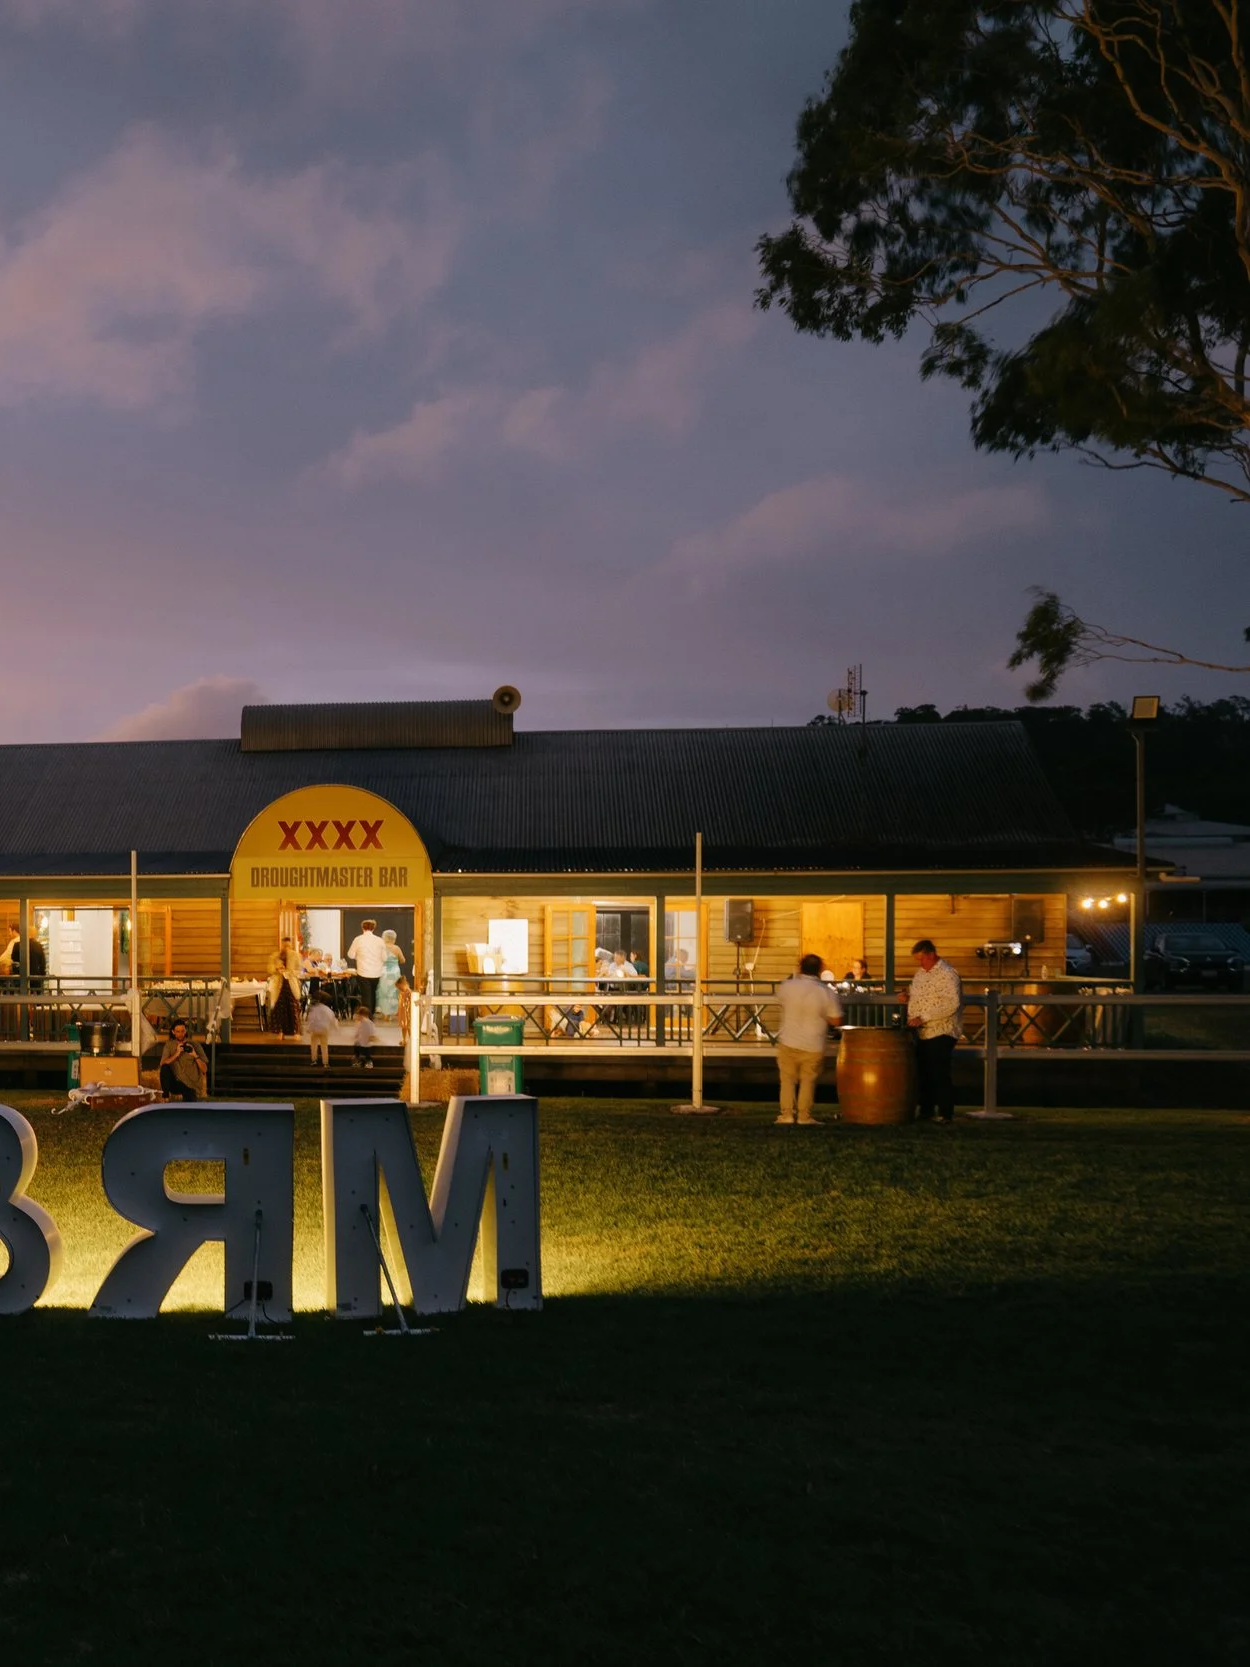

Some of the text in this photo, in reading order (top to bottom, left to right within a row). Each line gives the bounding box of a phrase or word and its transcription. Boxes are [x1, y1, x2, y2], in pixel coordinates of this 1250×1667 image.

[278, 820, 385, 850] XXXX
[251, 866, 408, 888] DROUGHTMASTER BAR
